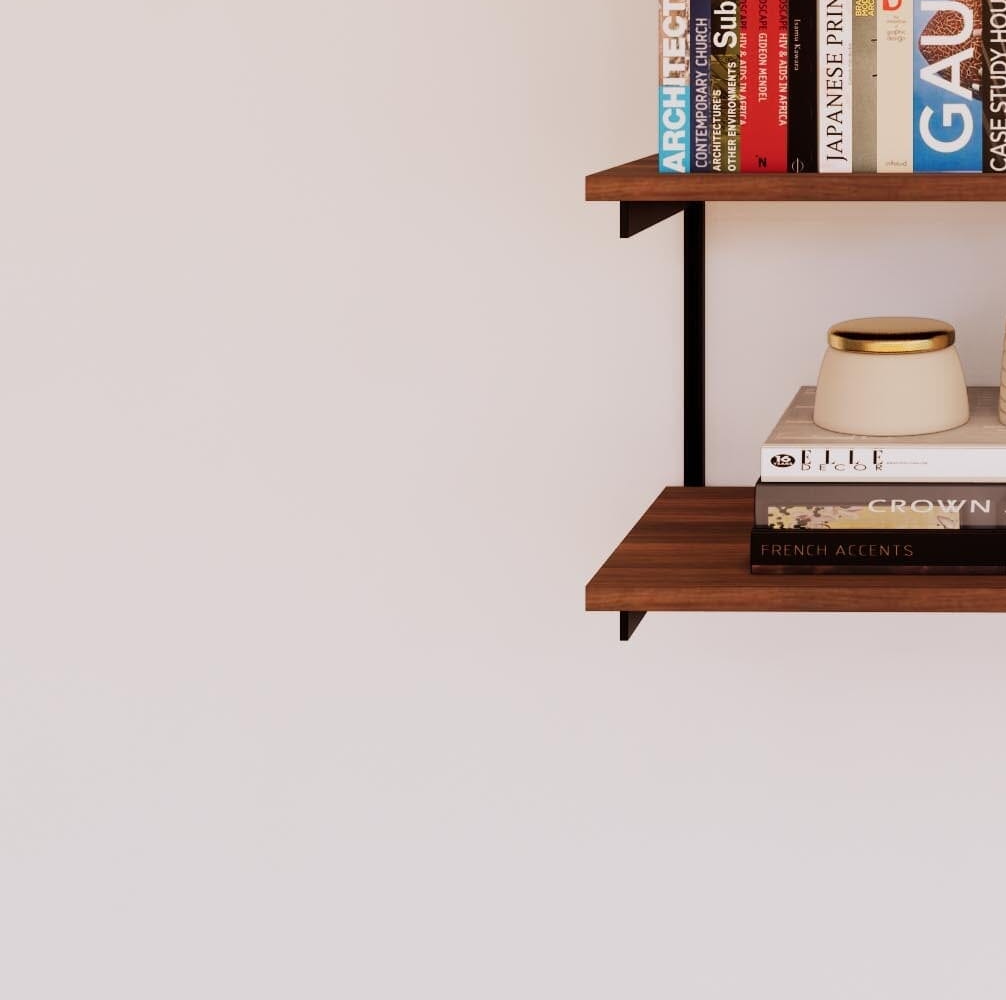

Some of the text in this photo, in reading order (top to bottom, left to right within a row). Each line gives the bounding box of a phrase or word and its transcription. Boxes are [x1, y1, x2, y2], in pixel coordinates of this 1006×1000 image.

[758, 32, 768, 66] GIDEON
[779, 32, 788, 49] HIV
[779, 59, 788, 80] AIDS
[695, 18, 708, 168] CONTEMPORARY CHURCH
[758, 67, 768, 102] MENDEL
[779, 82, 788, 93] IN
[727, 61, 737, 172] OTHER ENVIRONMENTS
[779, 95, 788, 126] AFRICA
[826, 53, 848, 161] JAPANESE
[712, 89, 722, 172] ARCHITECTURE'S
[801, 450, 884, 465] ELLE
[801, 463, 883, 471] DECOR
[868, 499, 991, 514] CROWN
[761, 544, 914, 557] FRENCH ACCENTS
